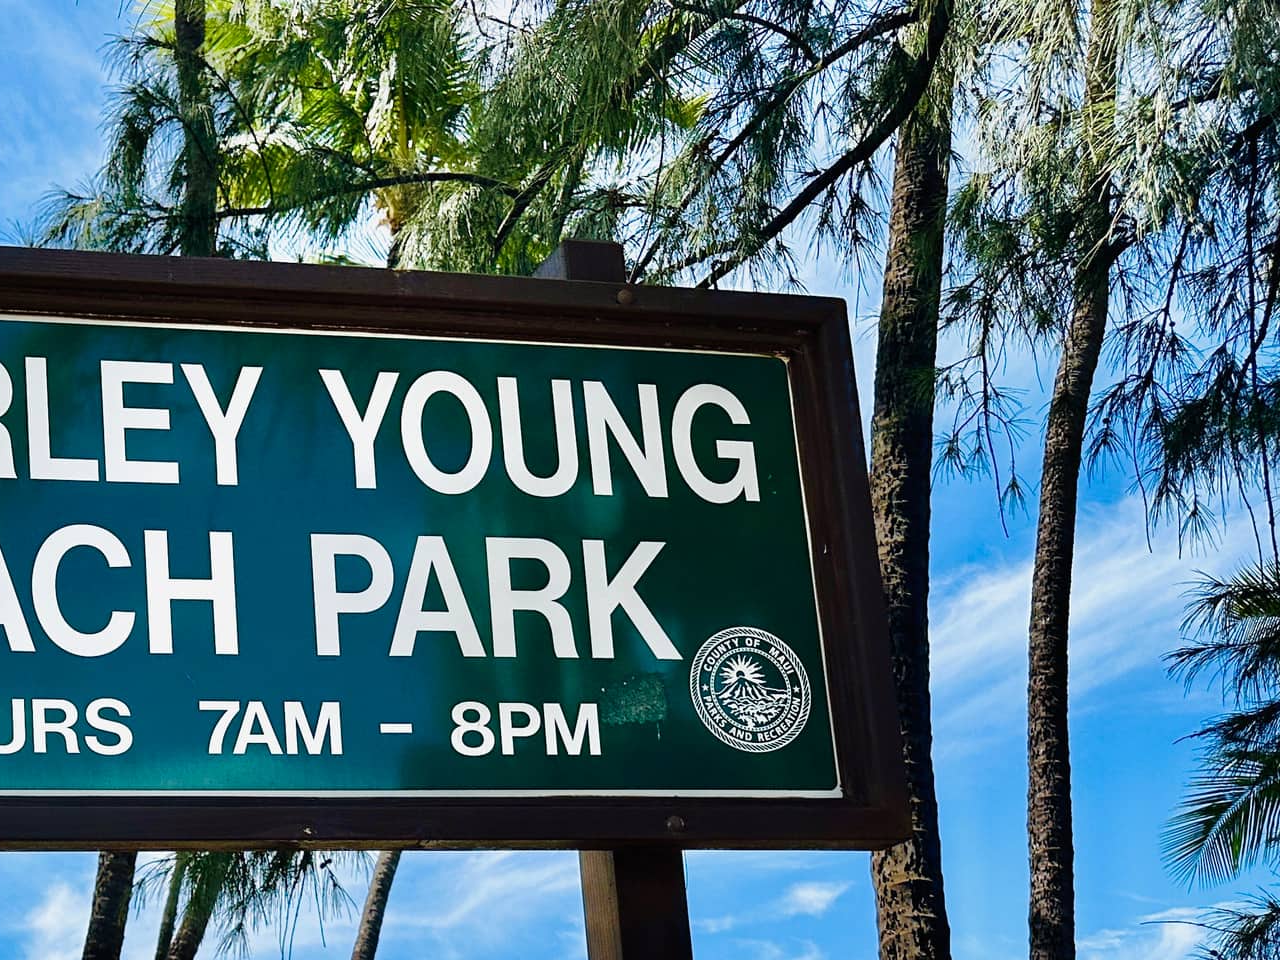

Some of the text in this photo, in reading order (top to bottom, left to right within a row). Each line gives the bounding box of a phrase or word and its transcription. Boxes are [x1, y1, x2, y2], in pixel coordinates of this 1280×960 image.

[318, 369, 761, 504] YOUNG
[310, 533, 683, 660] PARK
[703, 637, 795, 675] COUNTY OF MAUI
[199, 700, 343, 756] 7AM
[451, 701, 602, 757] 8PM
[703, 695, 802, 742] PARKS AND RECREATION
